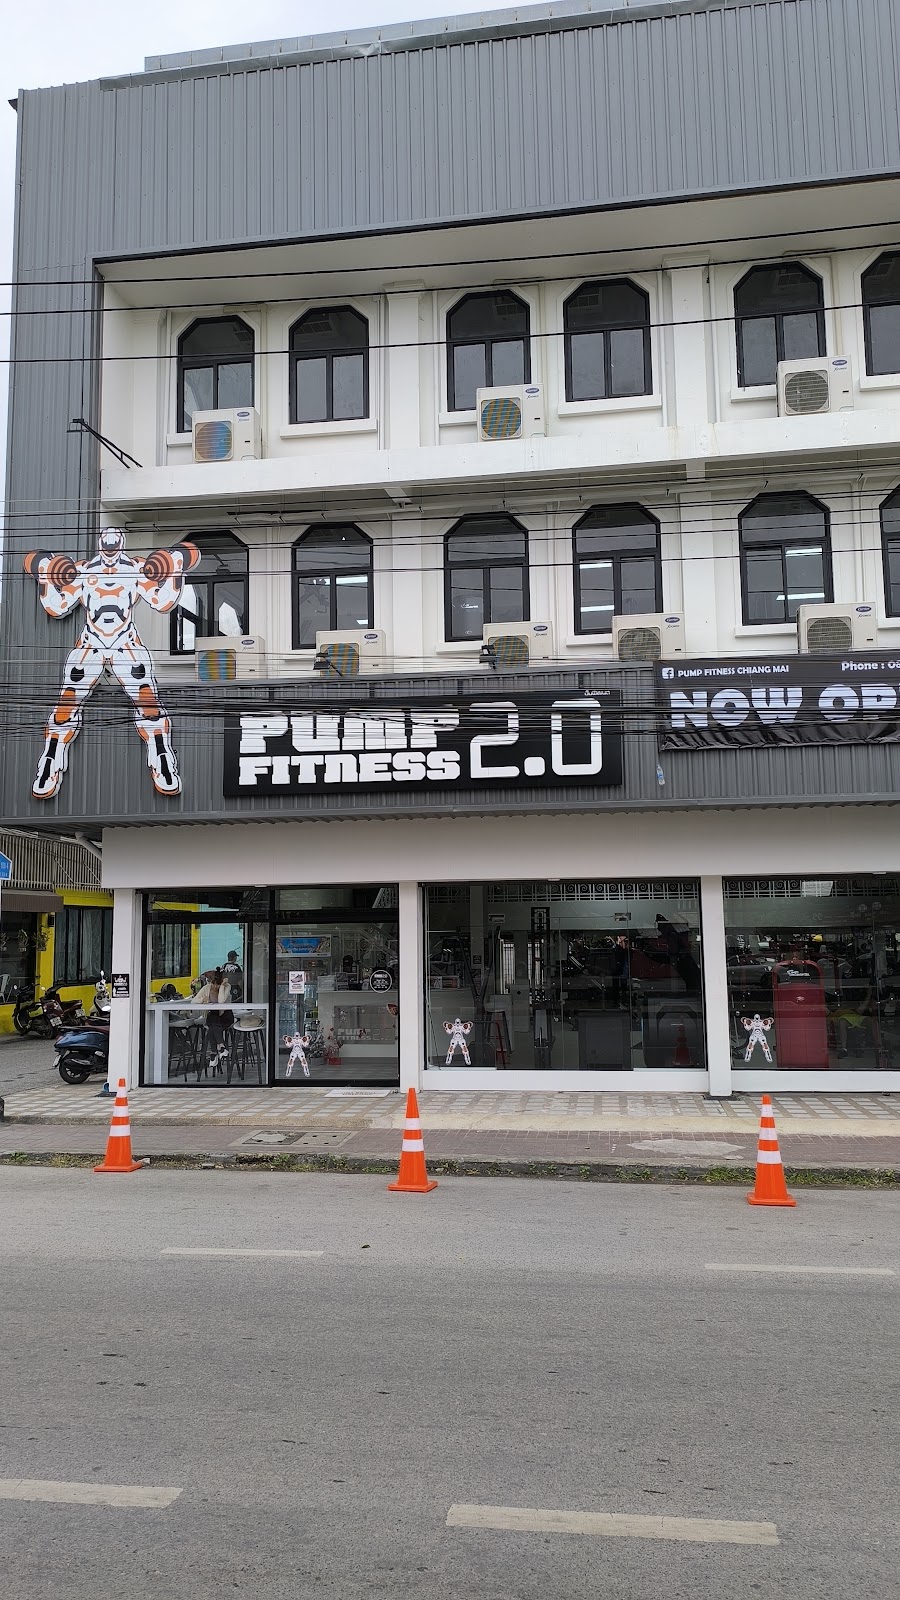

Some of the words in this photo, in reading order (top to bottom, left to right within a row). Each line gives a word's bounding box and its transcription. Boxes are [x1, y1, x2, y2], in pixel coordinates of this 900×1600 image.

[678, 669, 702, 677] PUMP
[704, 667, 735, 676] FITNESS
[737, 666, 771, 674] CHIANG
[772, 665, 789, 673] MAI
[842, 661, 878, 671] Phone
[670, 687, 803, 728] NOW
[819, 683, 900, 723] OP
[239, 708, 460, 754] PUMP
[469, 700, 603, 778] 2.0
[238, 750, 461, 786] FITNESS
